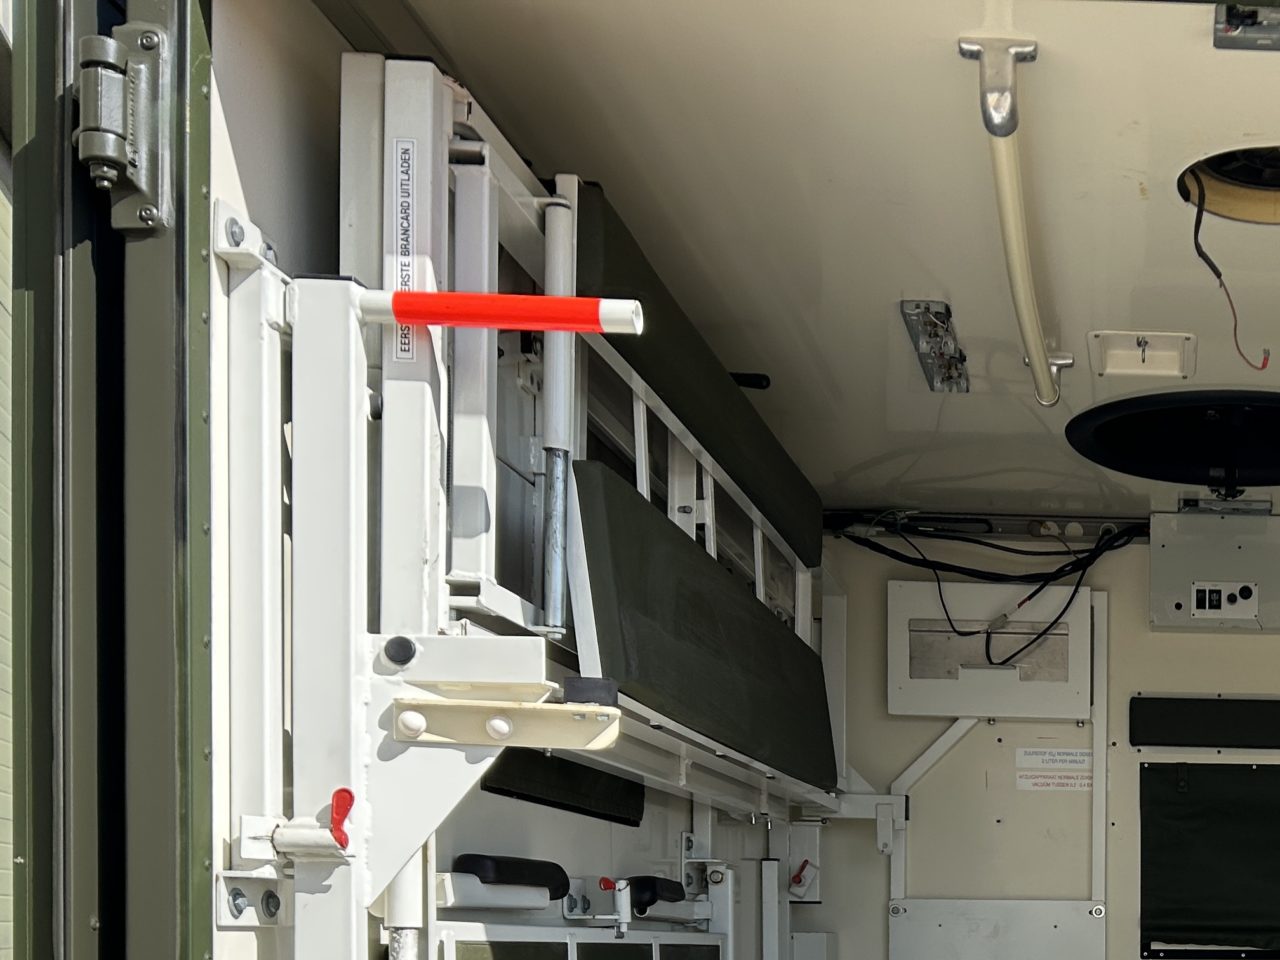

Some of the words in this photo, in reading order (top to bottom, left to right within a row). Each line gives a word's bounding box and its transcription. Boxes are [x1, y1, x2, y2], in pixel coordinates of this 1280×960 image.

[400, 148, 410, 198] UITLADEN
[400, 200, 410, 256] BRANCARD
[401, 324, 410, 352] EERS
